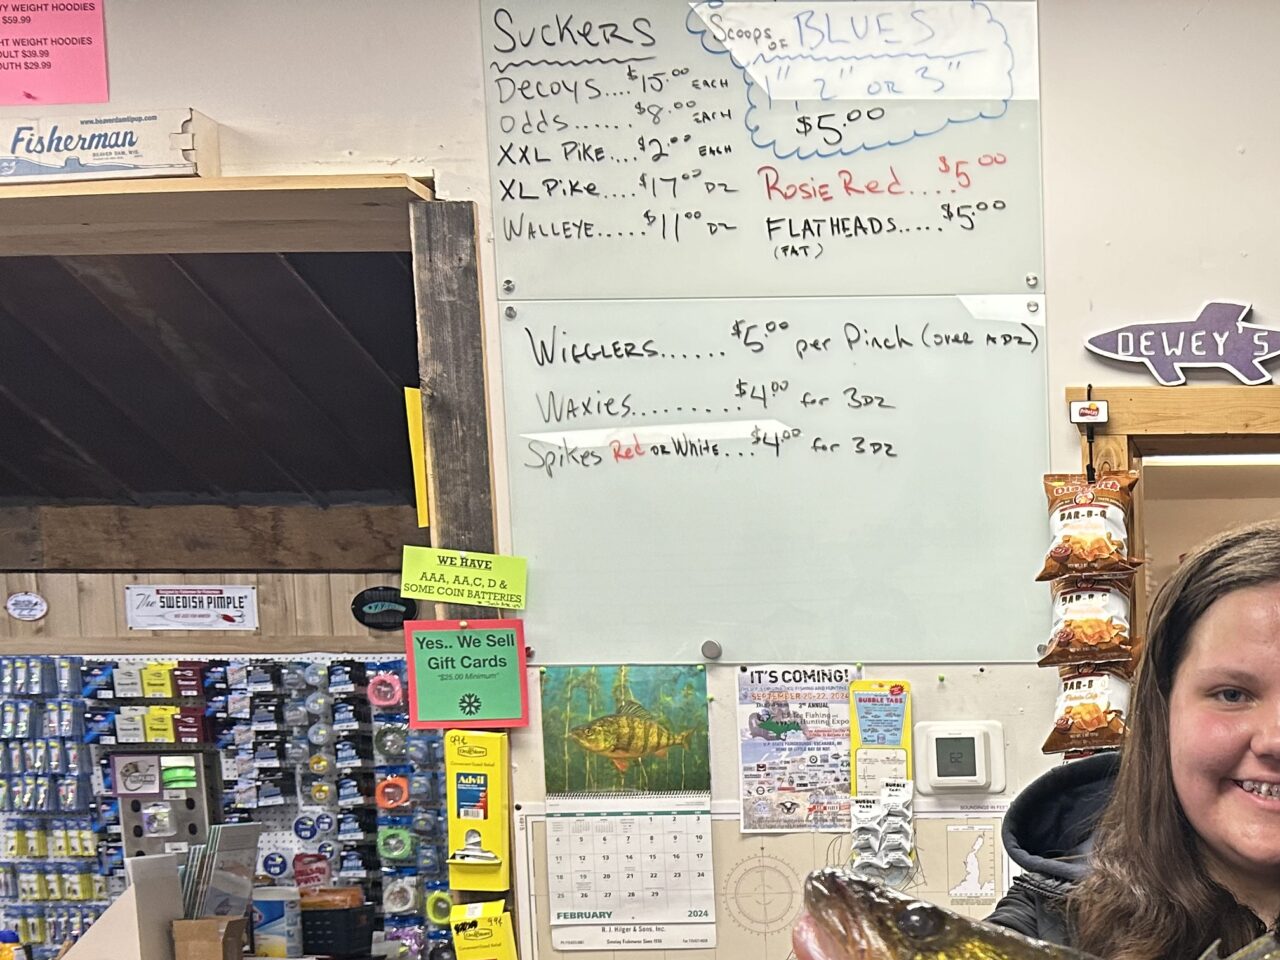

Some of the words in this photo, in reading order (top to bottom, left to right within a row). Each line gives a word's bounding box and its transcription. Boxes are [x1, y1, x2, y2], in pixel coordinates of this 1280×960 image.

[12, 4, 48, 12] WEIGHT
[51, 3, 96, 11] HOODIES
[2, 16, 31, 24] $59.99
[793, 10, 935, 50] BLUES
[12, 38, 48, 46] WEIGHT
[51, 37, 93, 46] HOODIES
[21, 50, 49, 58] $39.99
[24, 62, 51, 70] $29.99
[692, 79, 728, 89] EACH
[796, 107, 885, 145] $5.00
[11, 125, 138, 155] Fisherman
[497, 143, 551, 166] XXL
[698, 145, 732, 157] EACH
[500, 179, 539, 201] XL
[796, 337, 831, 358] per
[844, 322, 913, 350] Pinch
[1117, 320, 1268, 356] DEWEY'S
[800, 391, 829, 406] for
[524, 437, 602, 478] Spikes
[609, 433, 646, 462] Red
[811, 437, 840, 452] for
[1059, 510, 1107, 521] BAR-B-Q
[437, 555, 457, 566] WE
[460, 557, 492, 570] HAVE
[420, 572, 449, 583] AAA,
[488, 578, 497, 587] D
[499, 580, 508, 589] &
[404, 583, 434, 595] SOME
[437, 587, 465, 597] COIN
[467, 590, 522, 603] BATTERIES
[135, 593, 157, 610] The
[159, 595, 204, 609] SWEDISH
[207, 595, 245, 609] PIMPLE
[457, 636, 481, 648] We
[486, 634, 515, 647] Sell
[427, 657, 456, 670] Gift
[460, 655, 507, 668] Cards
[750, 670, 778, 684] IT'S
[782, 669, 849, 683] COMING!
[805, 712, 830, 720] Fishing
[459, 776, 484, 784] Advil
[557, 911, 613, 920] FEBRUARY
